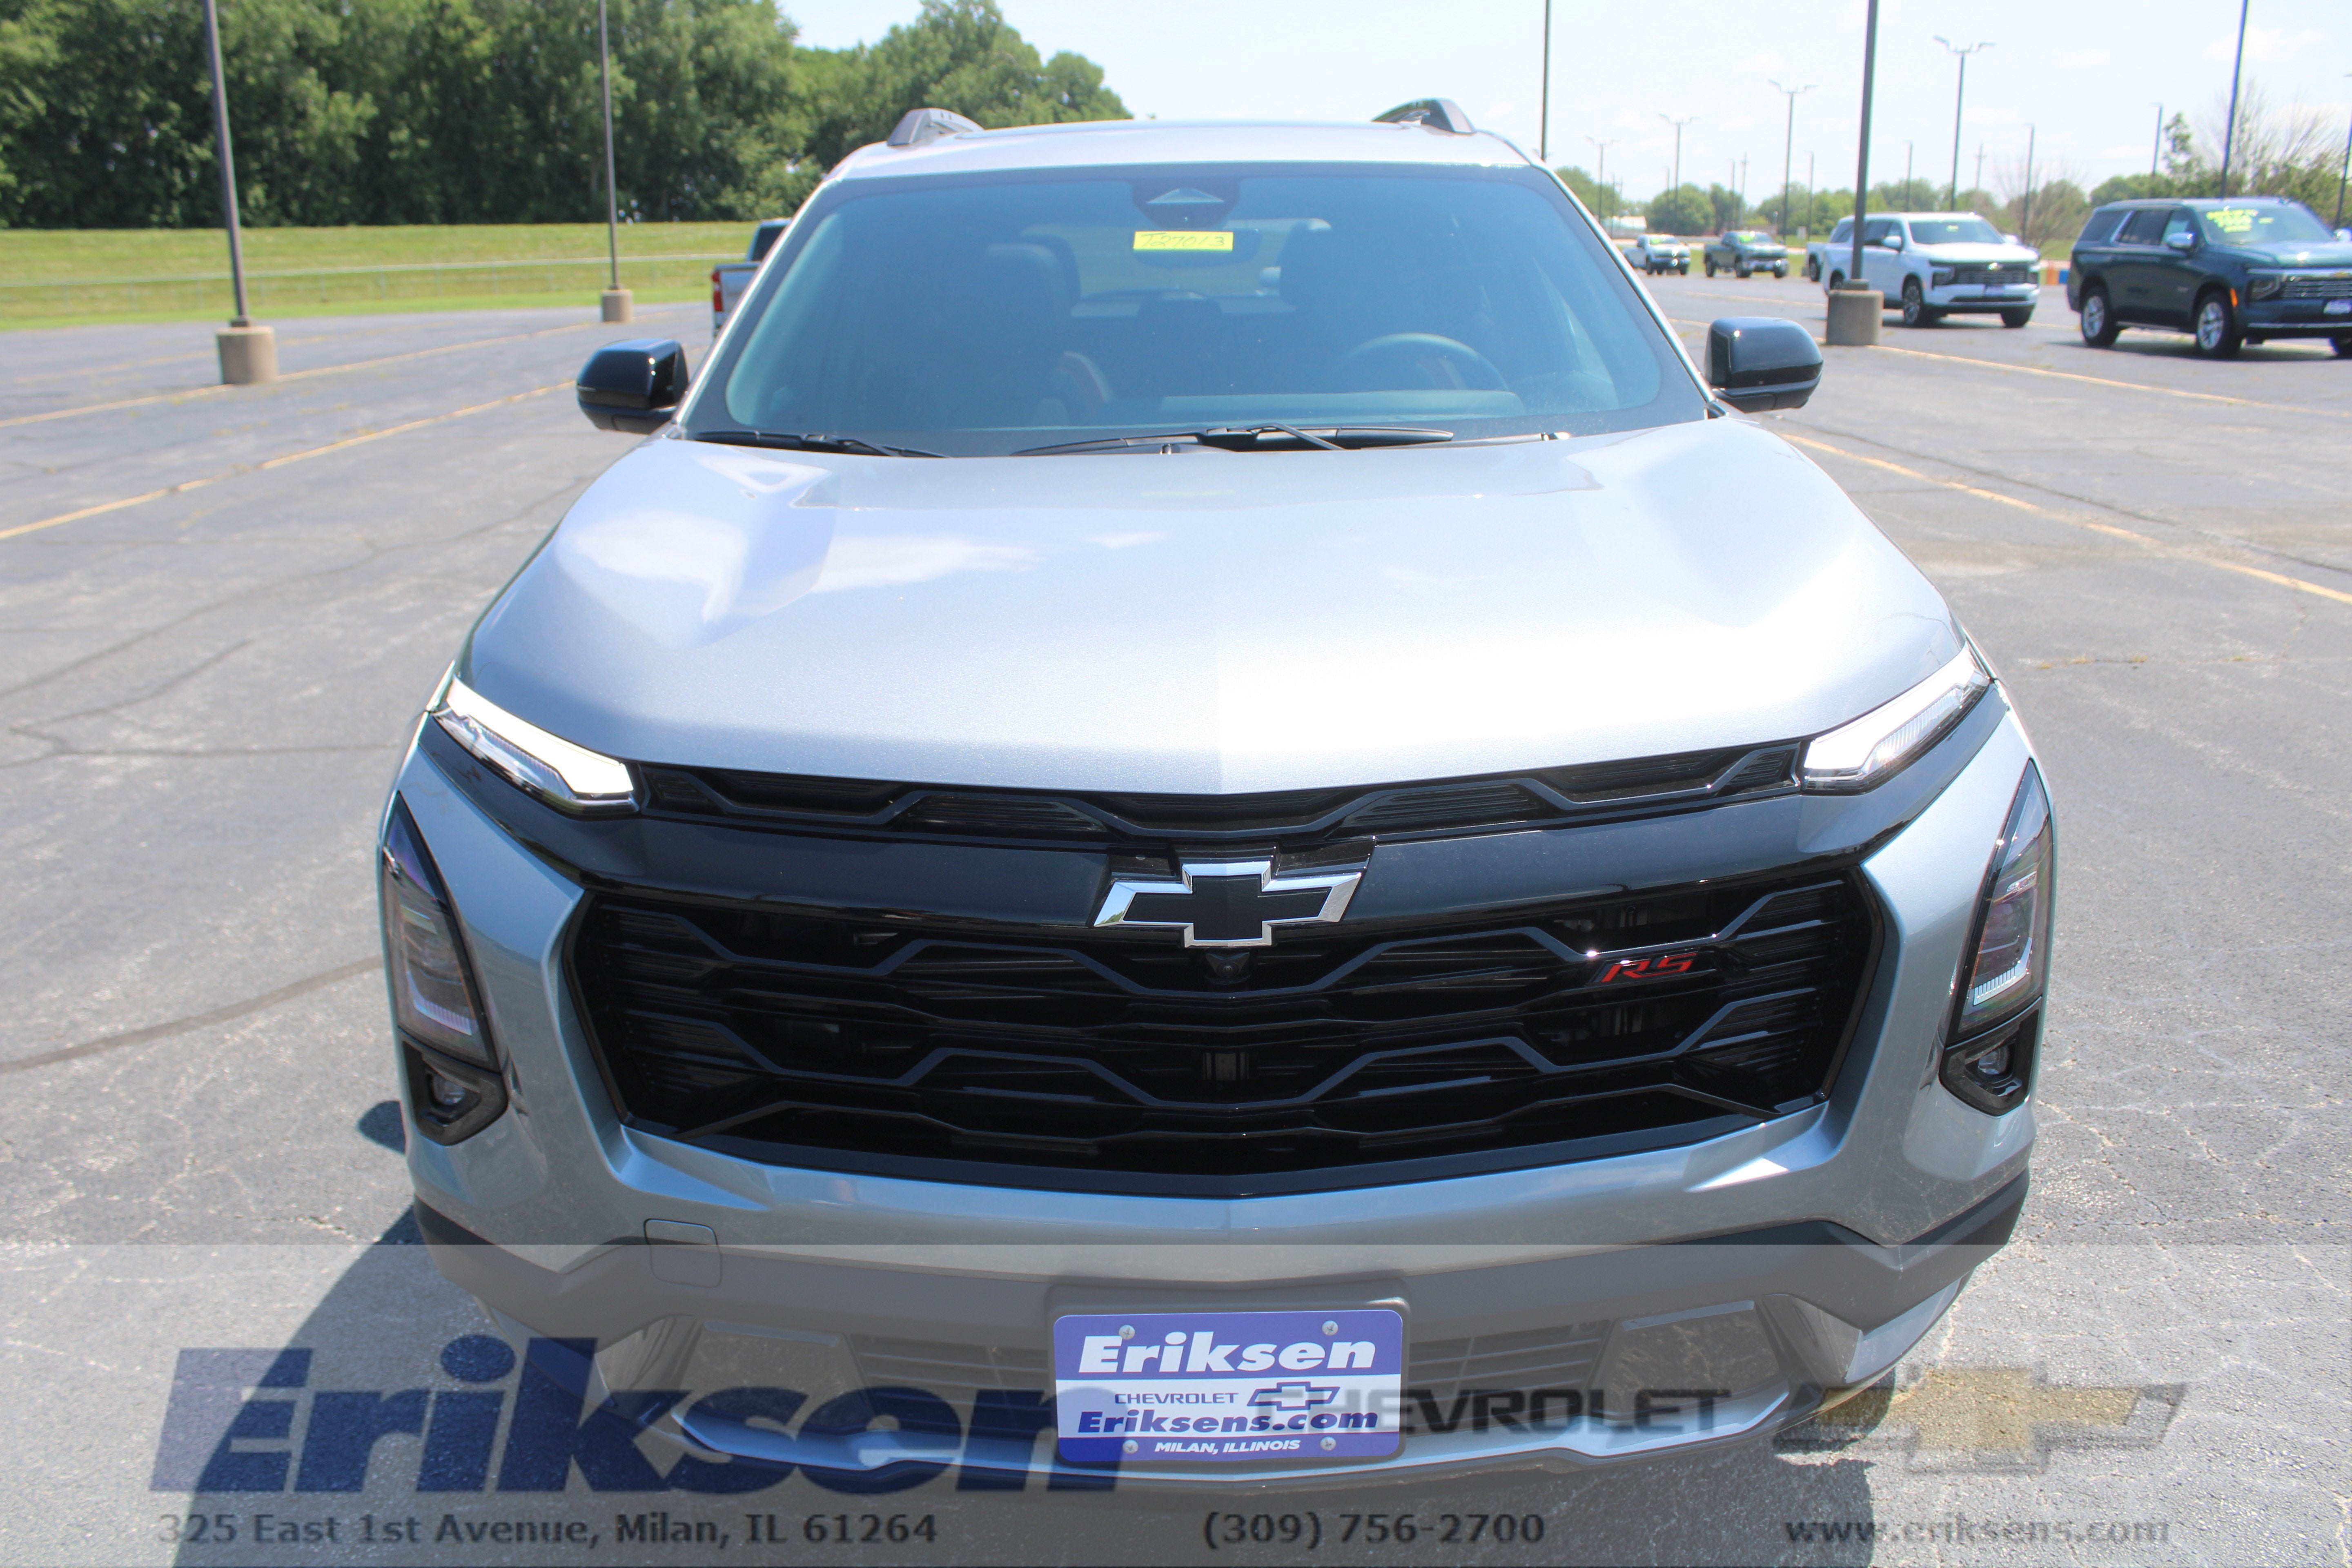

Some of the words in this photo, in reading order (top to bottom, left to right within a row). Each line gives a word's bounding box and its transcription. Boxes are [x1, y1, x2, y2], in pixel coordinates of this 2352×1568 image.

[1596, 952, 1697, 983] RS
[1078, 1331, 1376, 1373] Eriksen
[1115, 1392, 1239, 1405] CHEVROLET
[1078, 1409, 1378, 1434] Eriksens.com
[1154, 1441, 1218, 1455] MILAN,
[1222, 1439, 1301, 1453] ILLINOIS
